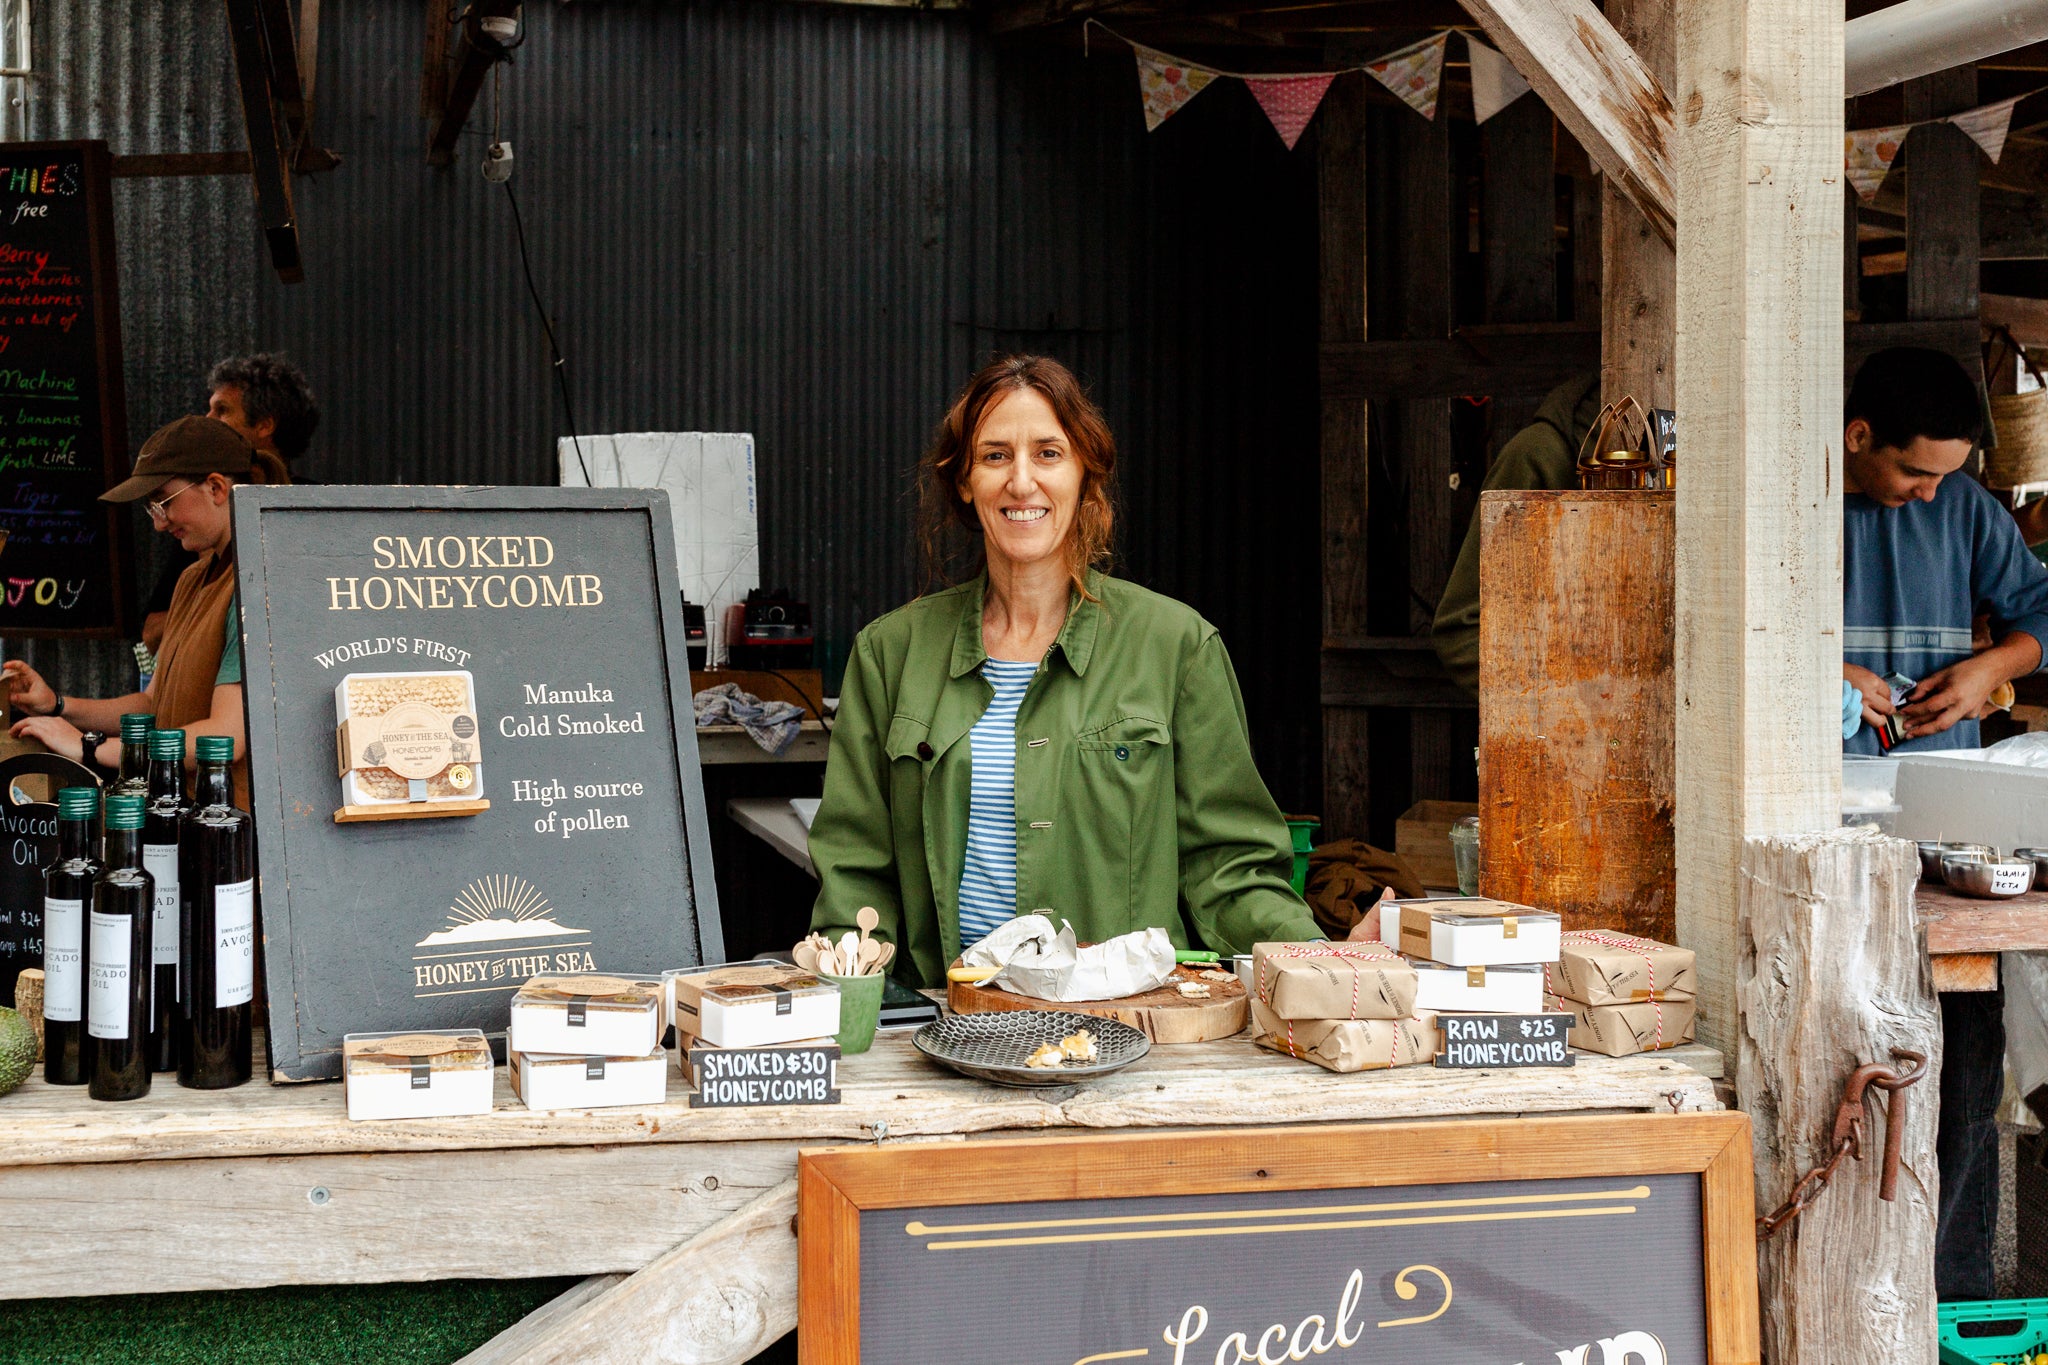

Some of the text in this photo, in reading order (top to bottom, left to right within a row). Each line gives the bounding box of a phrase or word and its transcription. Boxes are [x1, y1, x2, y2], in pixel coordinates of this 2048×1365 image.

[9, 200, 48, 225] free
[0, 368, 77, 391] Machine
[372, 535, 555, 570] SMOKED
[326, 574, 604, 610] HONEYCOMB
[313, 636, 471, 670] WORLD'S FIRST
[523, 683, 614, 705] Manuka
[382, 733, 410, 743] HONEY
[416, 732, 432, 741] THE
[433, 731, 449, 740] SEA
[499, 716, 551, 738] Cold
[557, 712, 645, 735] Smoked
[392, 745, 441, 755] HONEYCOMB
[512, 779, 643, 807] High source
[534, 807, 629, 839] of pollen
[13, 839, 38, 866] Oil
[20, 910, 41, 927] $24
[22, 937, 43, 955] $45
[46, 964, 62, 973] OIL
[414, 952, 597, 987] HONEY BY THE SEA
[92, 979, 109, 989] OIL
[1447, 1019, 1556, 1040] RAW $25
[1447, 1040, 1566, 1065] HONEYCOMB
[704, 1052, 827, 1080] SMOKED $30
[703, 1078, 827, 1104] HONEYCOMB
[1163, 1268, 1364, 1365] Local
